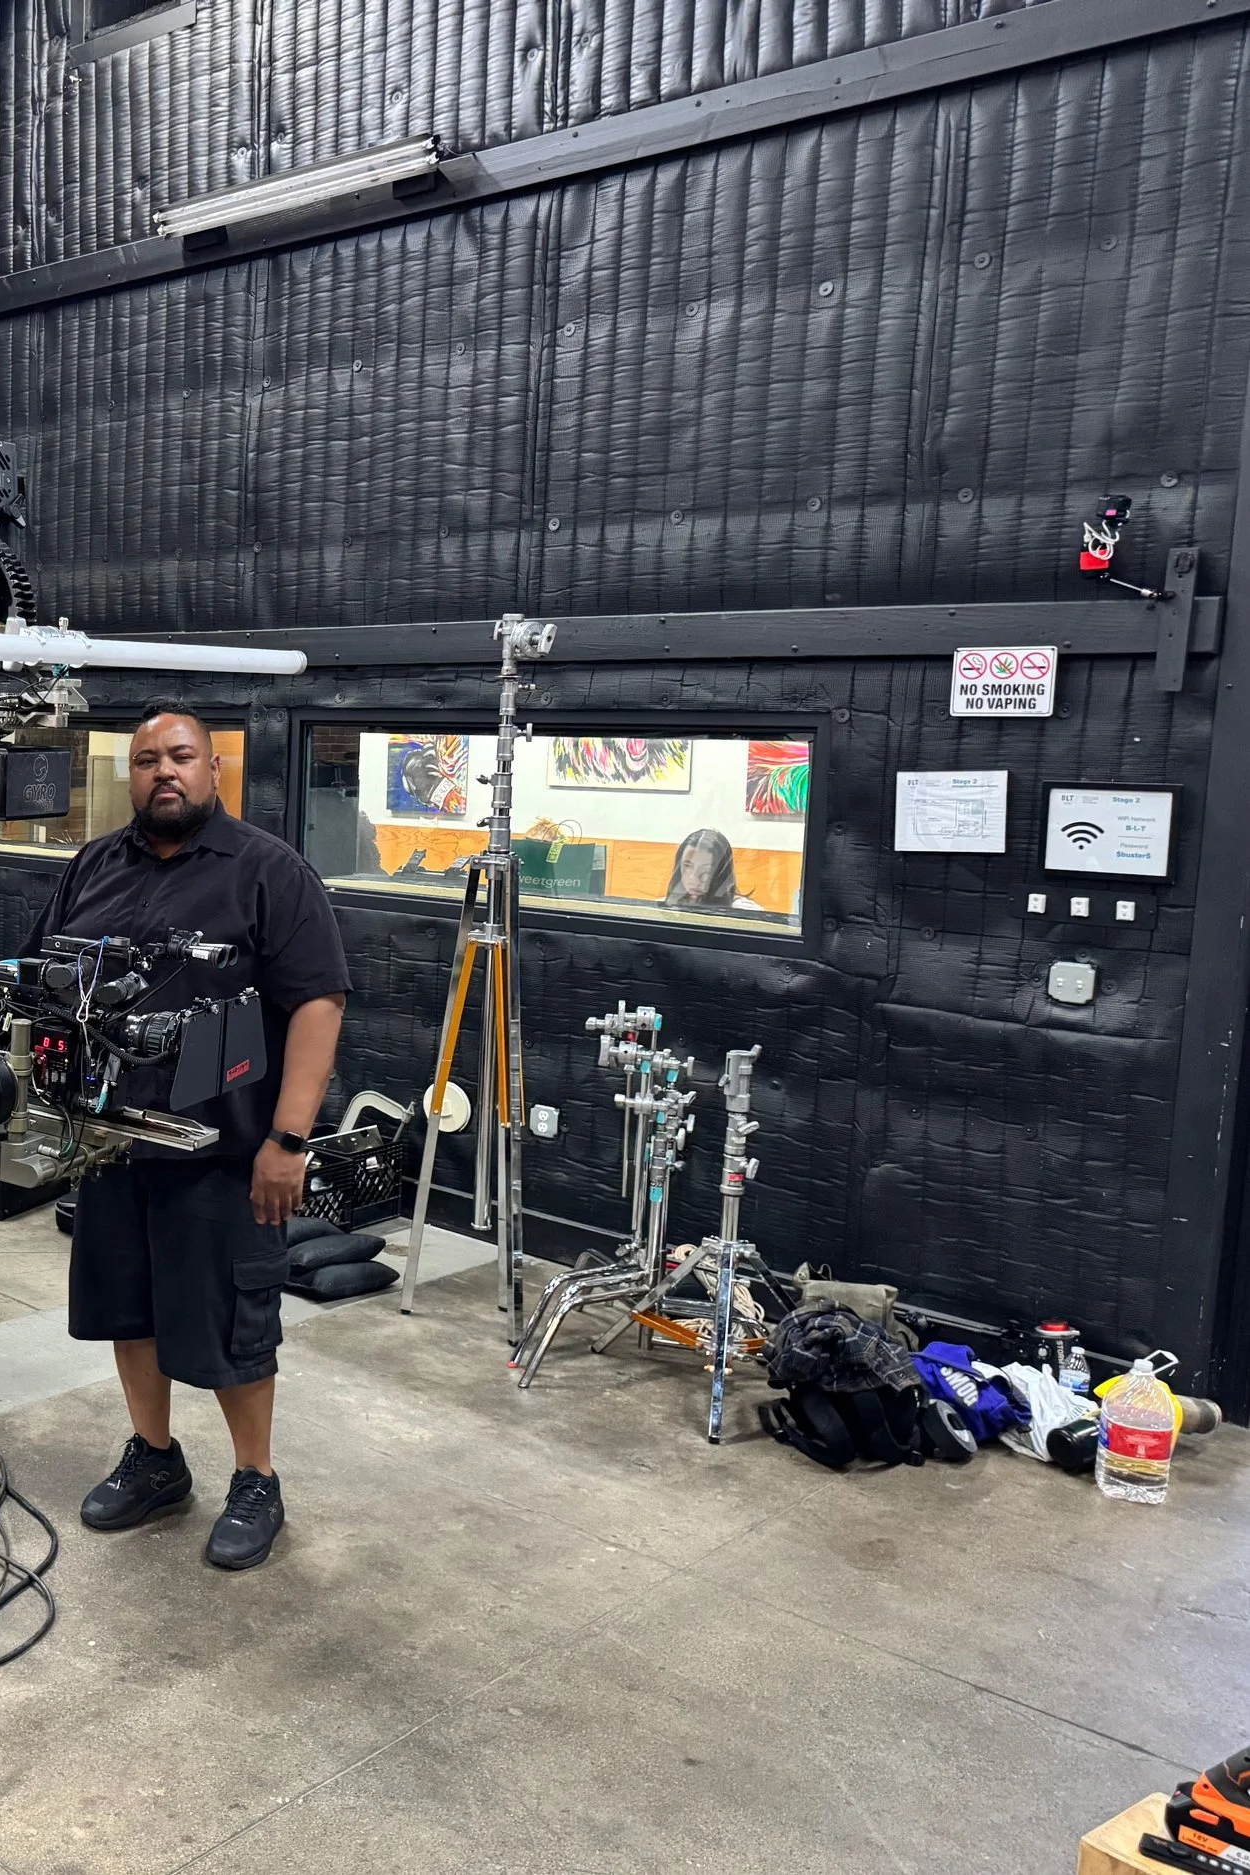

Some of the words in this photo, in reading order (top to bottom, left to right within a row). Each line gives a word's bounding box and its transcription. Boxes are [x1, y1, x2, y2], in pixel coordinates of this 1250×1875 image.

[959, 683, 978, 696] NO
[981, 683, 1045, 696] SMOKING
[965, 697, 983, 710] NO
[987, 697, 1037, 710] VAPING
[22, 782, 56, 801] GYRO
[1112, 796, 1133, 804] Stage
[1125, 824, 1146, 832] B-L-T
[517, 874, 581, 889] weetgreen
